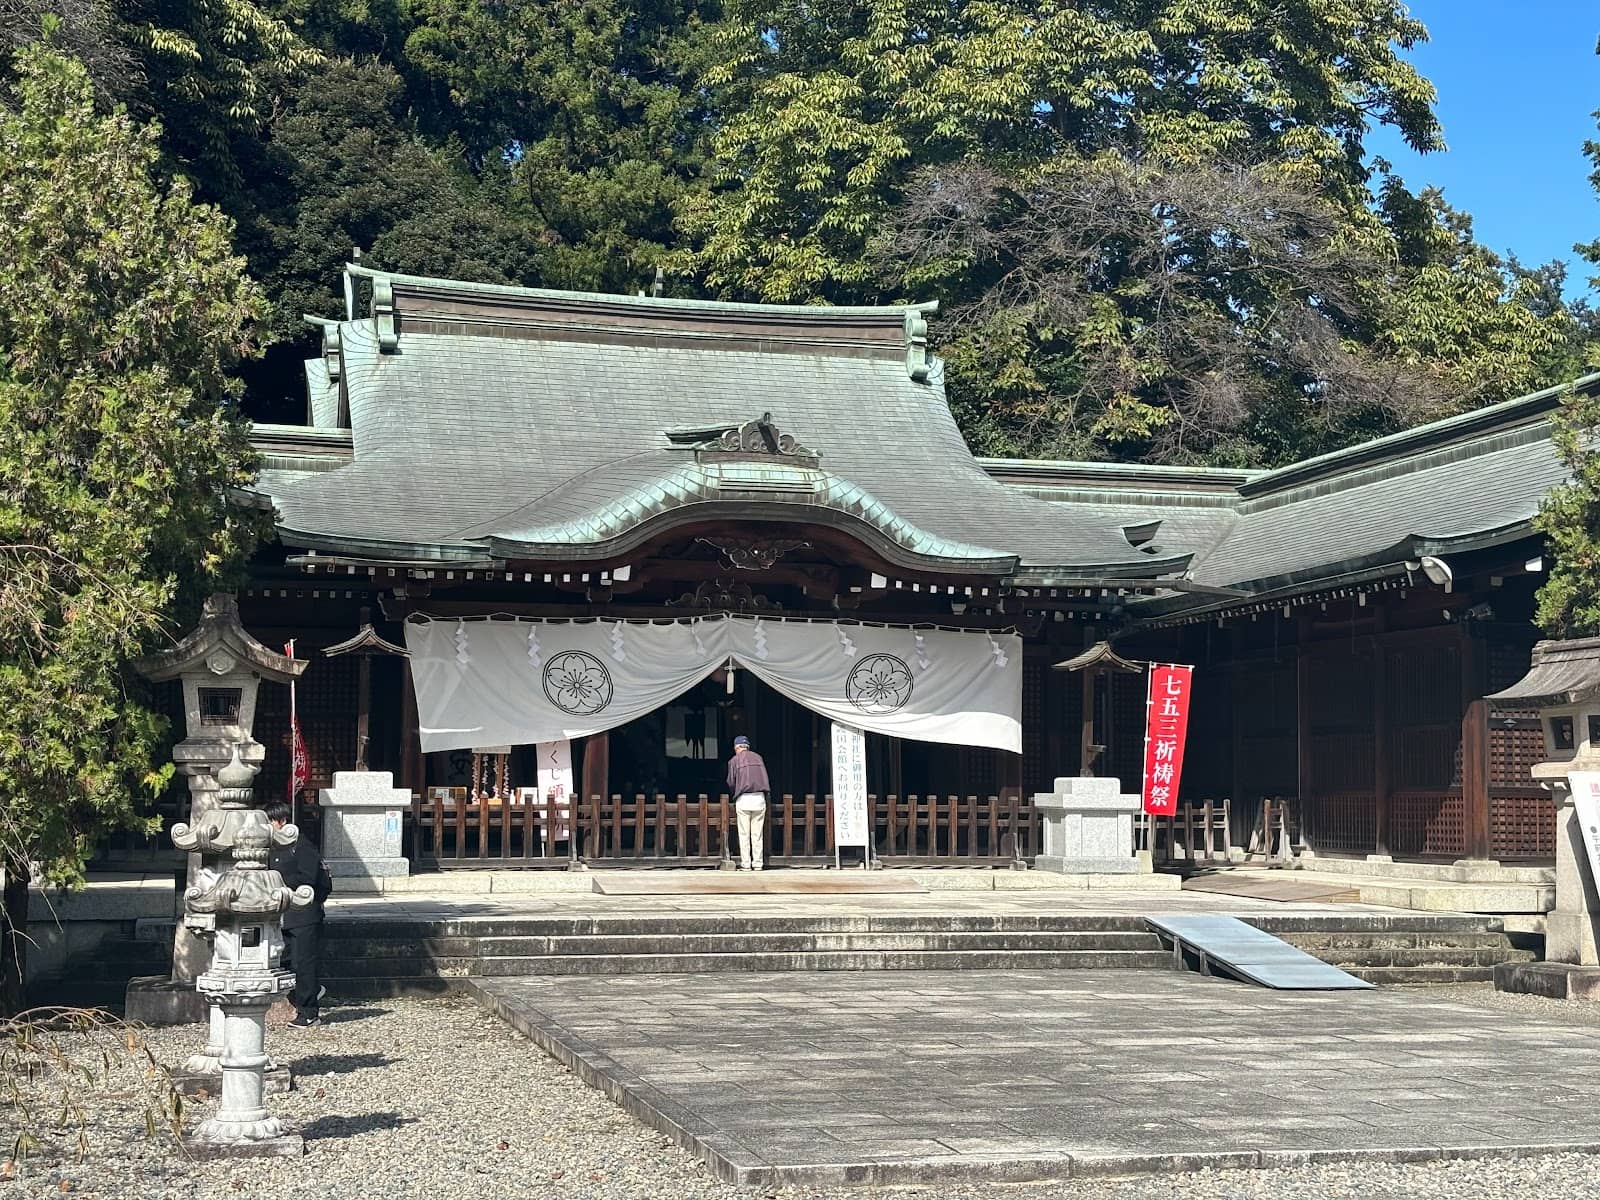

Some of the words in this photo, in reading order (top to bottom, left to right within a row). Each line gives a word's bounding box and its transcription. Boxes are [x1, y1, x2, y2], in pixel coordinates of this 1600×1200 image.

[1150, 674, 1182, 807] 七五三祈祷祭
